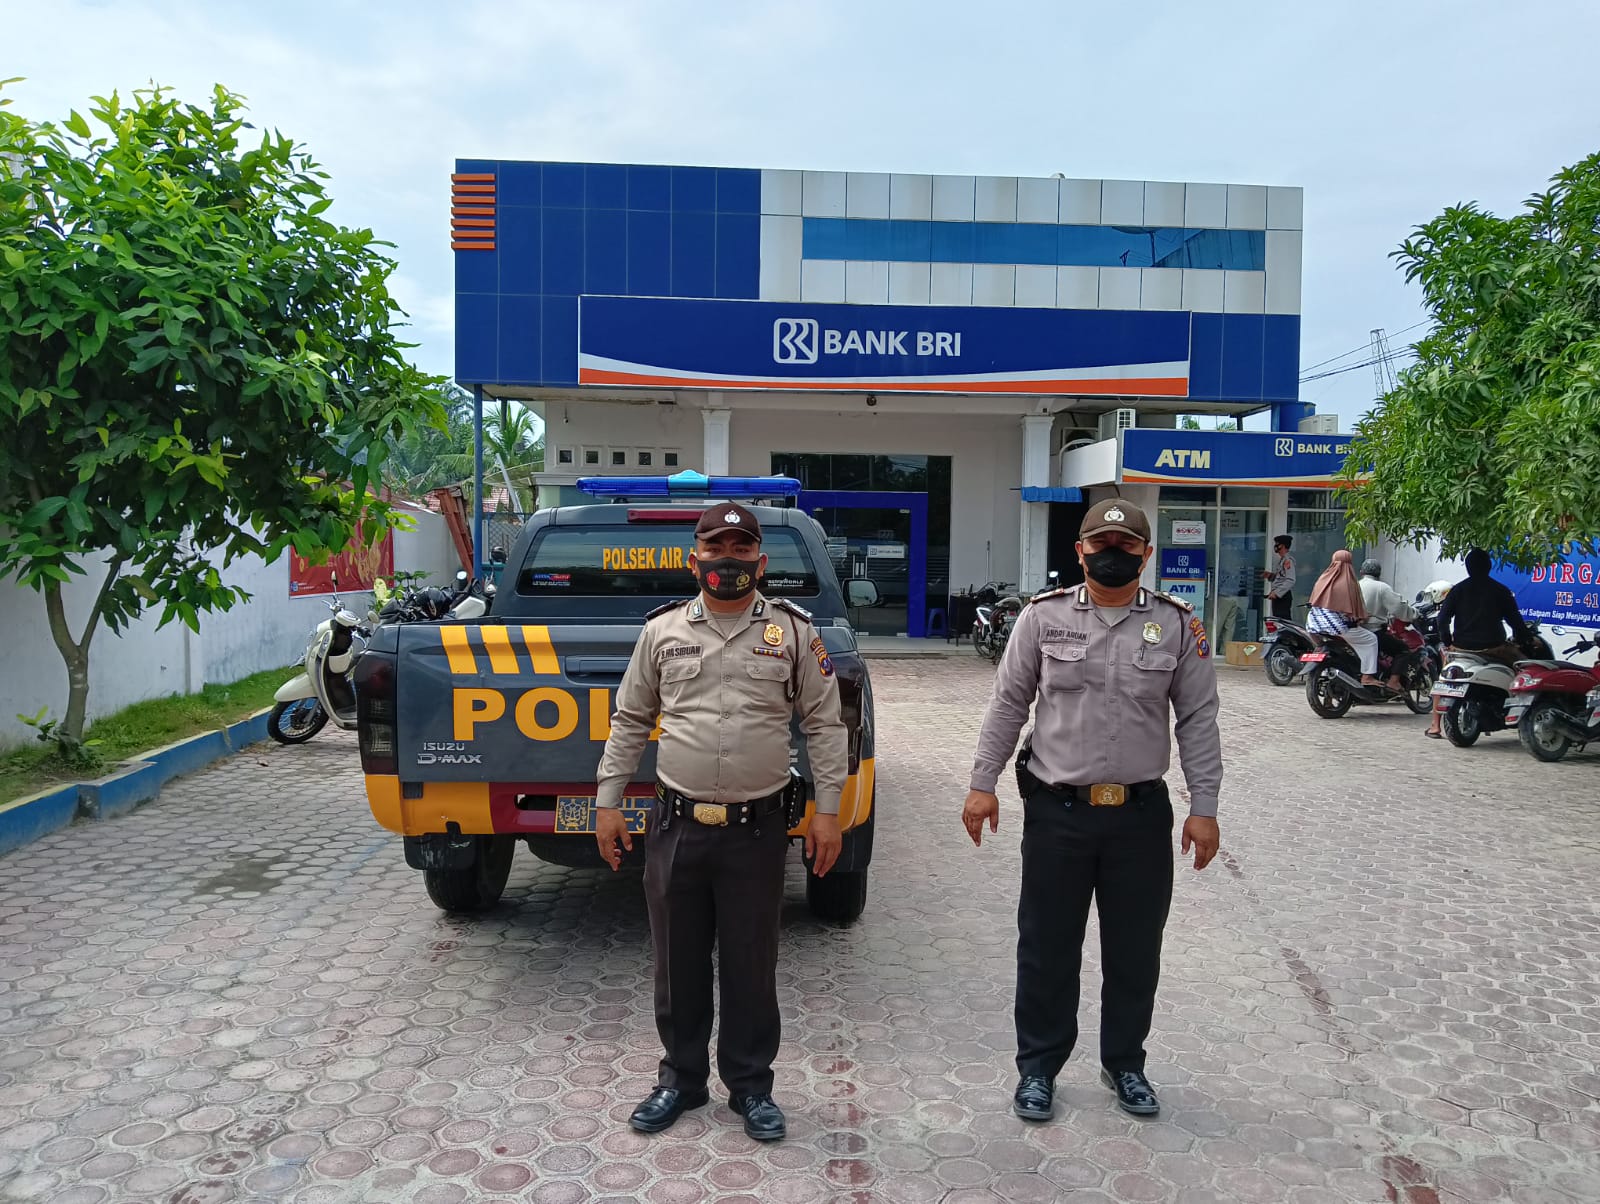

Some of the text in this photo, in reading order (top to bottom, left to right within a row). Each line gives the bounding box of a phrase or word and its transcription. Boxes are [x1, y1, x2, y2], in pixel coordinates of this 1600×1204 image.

[824, 330, 961, 357] BANK BRI
[1297, 443, 1332, 455] BANK
[1154, 449, 1211, 469] ATM
[602, 547, 655, 570] POLSEK
[660, 546, 683, 569] AIR
[1532, 563, 1600, 584] DIRG
[1169, 585, 1196, 593] ATM
[1555, 591, 1573, 606] KE
[1583, 593, 1599, 608] 41
[1528, 608, 1551, 618] Satpam
[1552, 610, 1565, 620] Siap
[1565, 611, 1591, 622] Menjaga
[453, 687, 664, 741] POL
[423, 742, 465, 752] ISUZU
